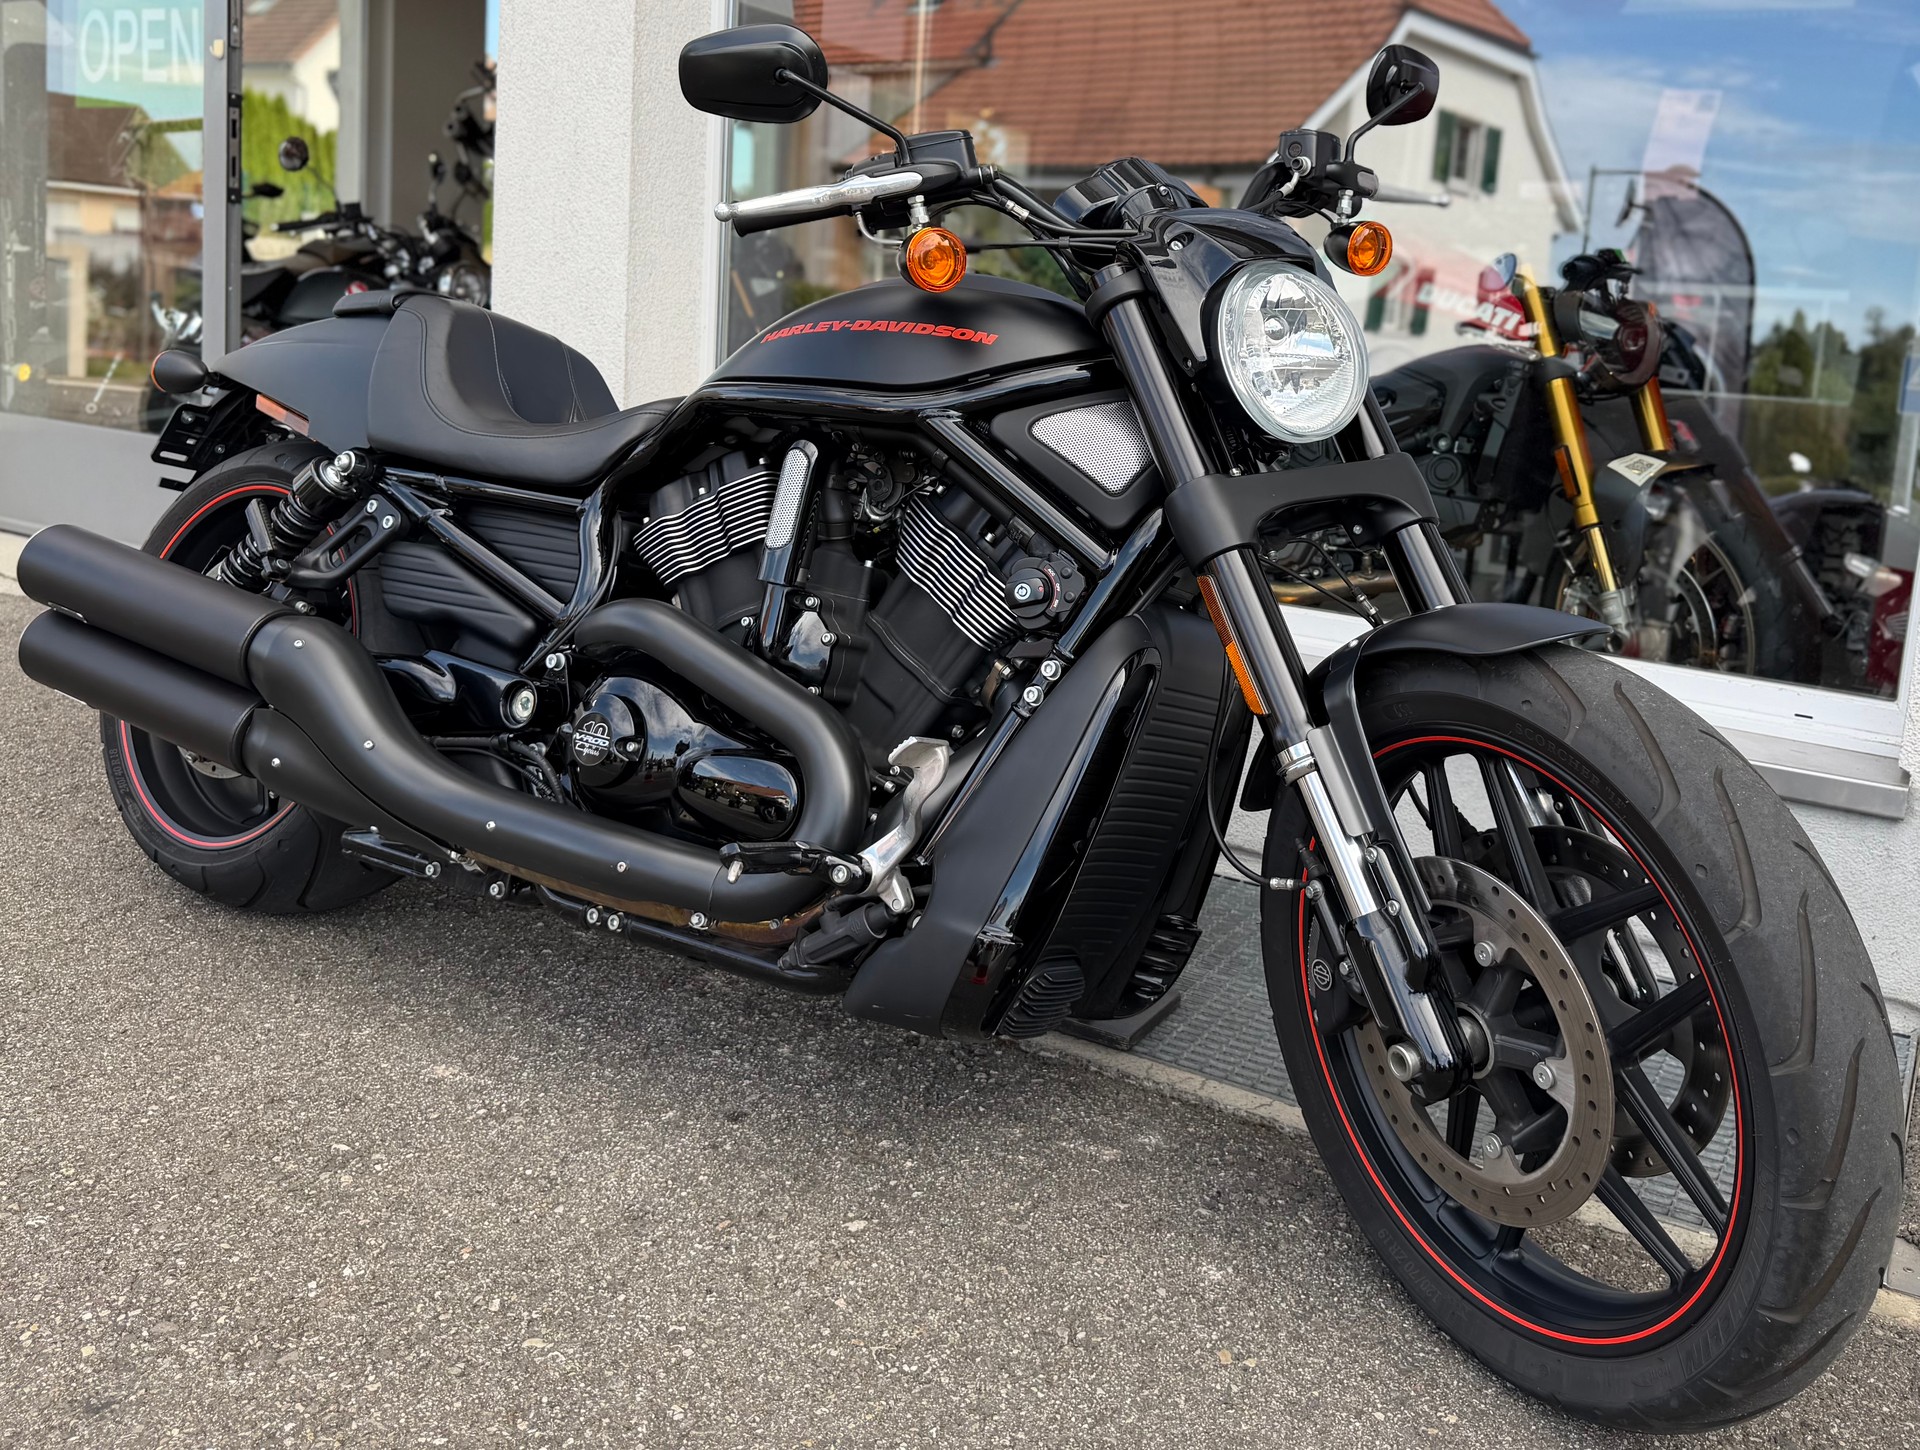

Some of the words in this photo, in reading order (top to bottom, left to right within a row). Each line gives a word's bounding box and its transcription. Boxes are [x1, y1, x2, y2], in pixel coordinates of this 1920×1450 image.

[80, 7, 203, 83] OPEN
[760, 319, 999, 346] HARLEY-DAVIDSON
[575, 732, 609, 746] V-ROD
[583, 720, 608, 737] 10
[1514, 722, 1601, 788] SCORCHER
[1401, 1255, 1442, 1307] 120/70
